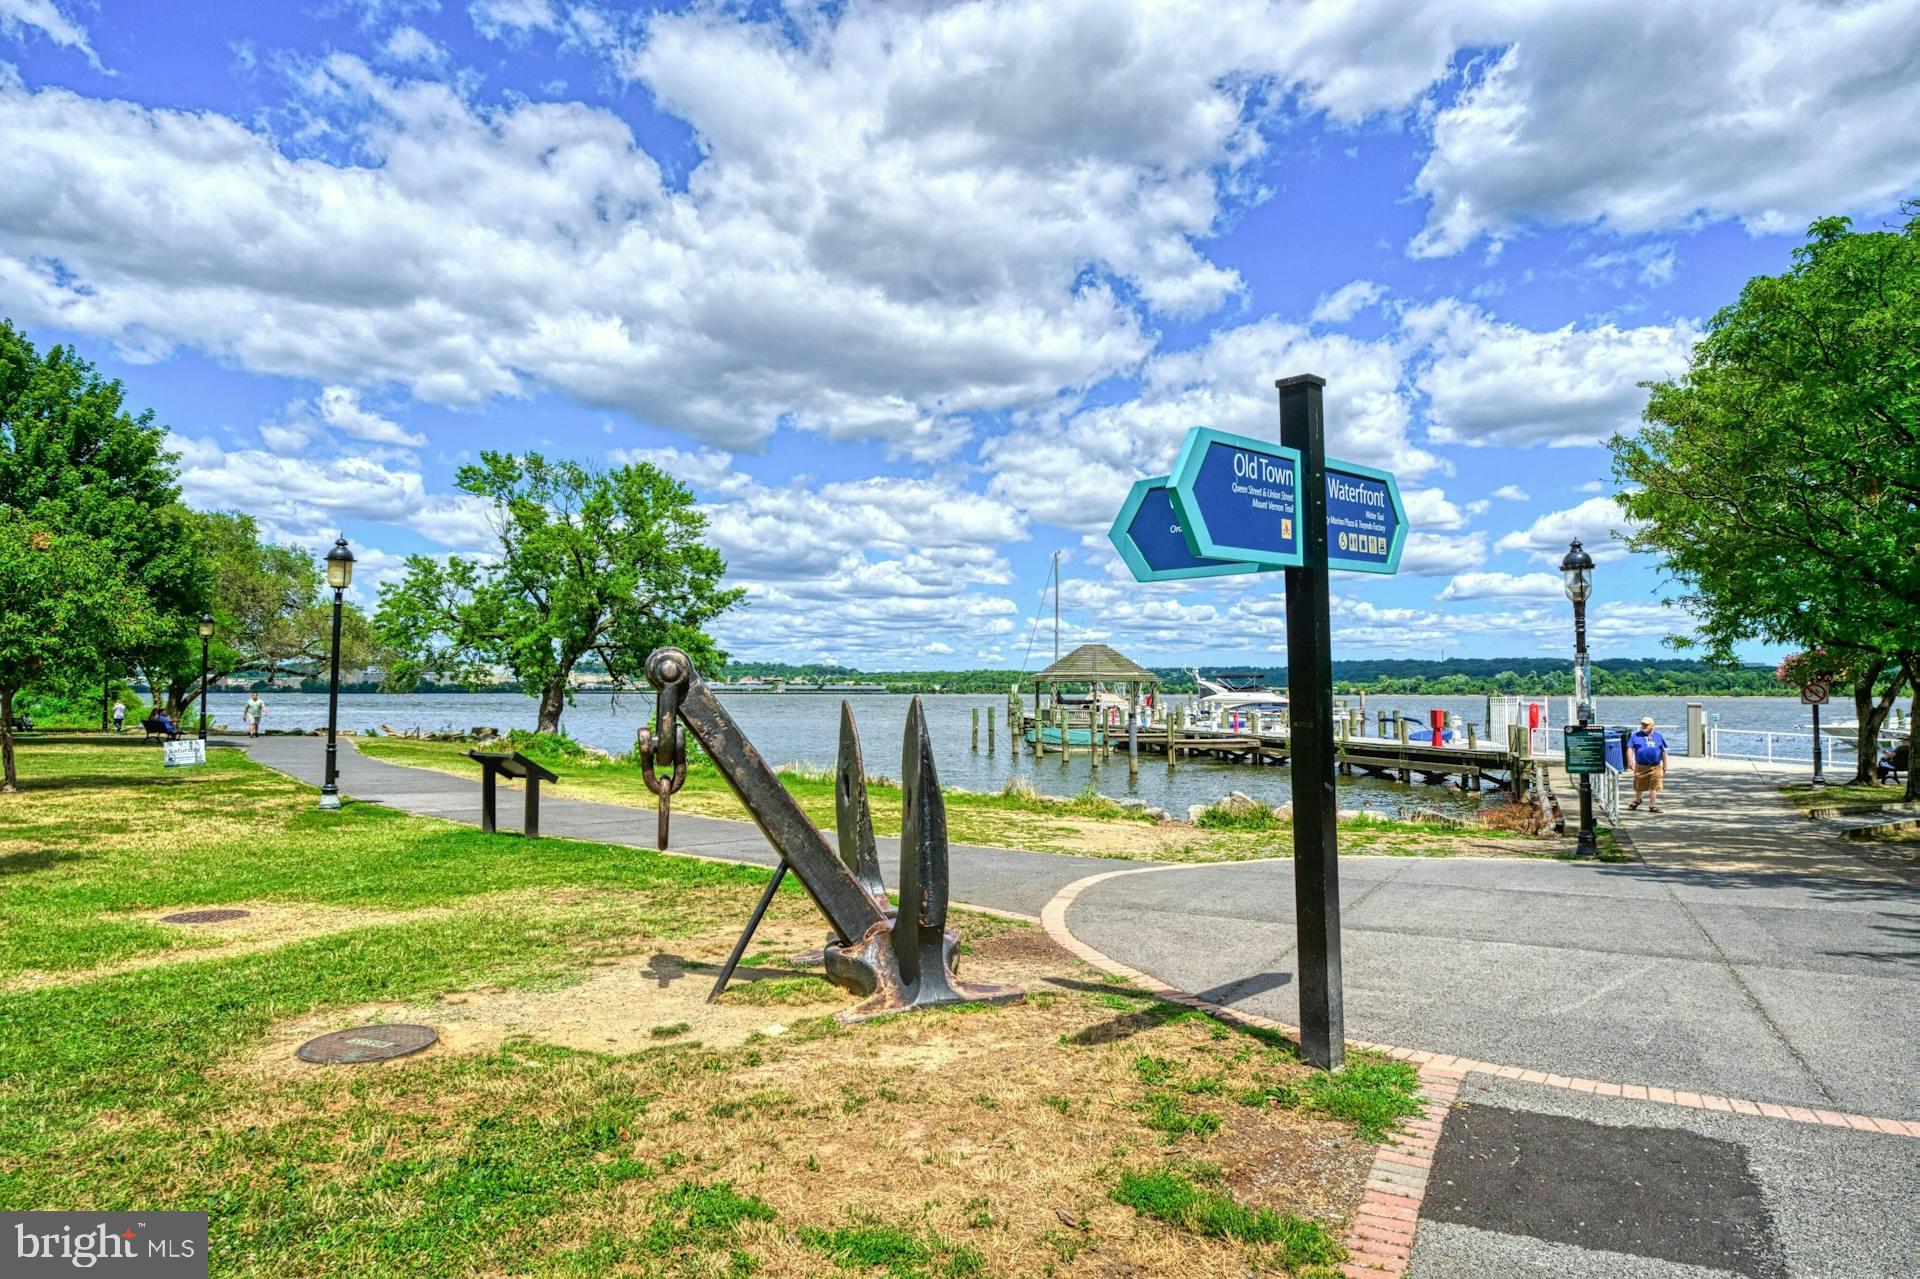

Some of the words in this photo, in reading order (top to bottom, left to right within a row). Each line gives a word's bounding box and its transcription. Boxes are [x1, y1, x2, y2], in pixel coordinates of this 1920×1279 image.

[1234, 453, 1258, 480] Old
[1259, 458, 1294, 487] Town
[1231, 482, 1248, 494] Queen
[1248, 485, 1262, 496] Street
[1262, 487, 1267, 497] &
[1267, 488, 1281, 500] Union
[1281, 490, 1294, 502] Street
[1327, 477, 1384, 507] Waterfront
[1252, 498, 1268, 509] Mount
[1268, 500, 1284, 512] Vernon
[1284, 503, 1294, 514] Trail
[1365, 511, 1377, 520] Water
[1330, 515, 1345, 526] Marina
[1345, 518, 1355, 527] Plaza
[1358, 520, 1372, 530] Torpedo
[1372, 522, 1386, 534] Factory
[168, 746, 201, 754] Saturday
